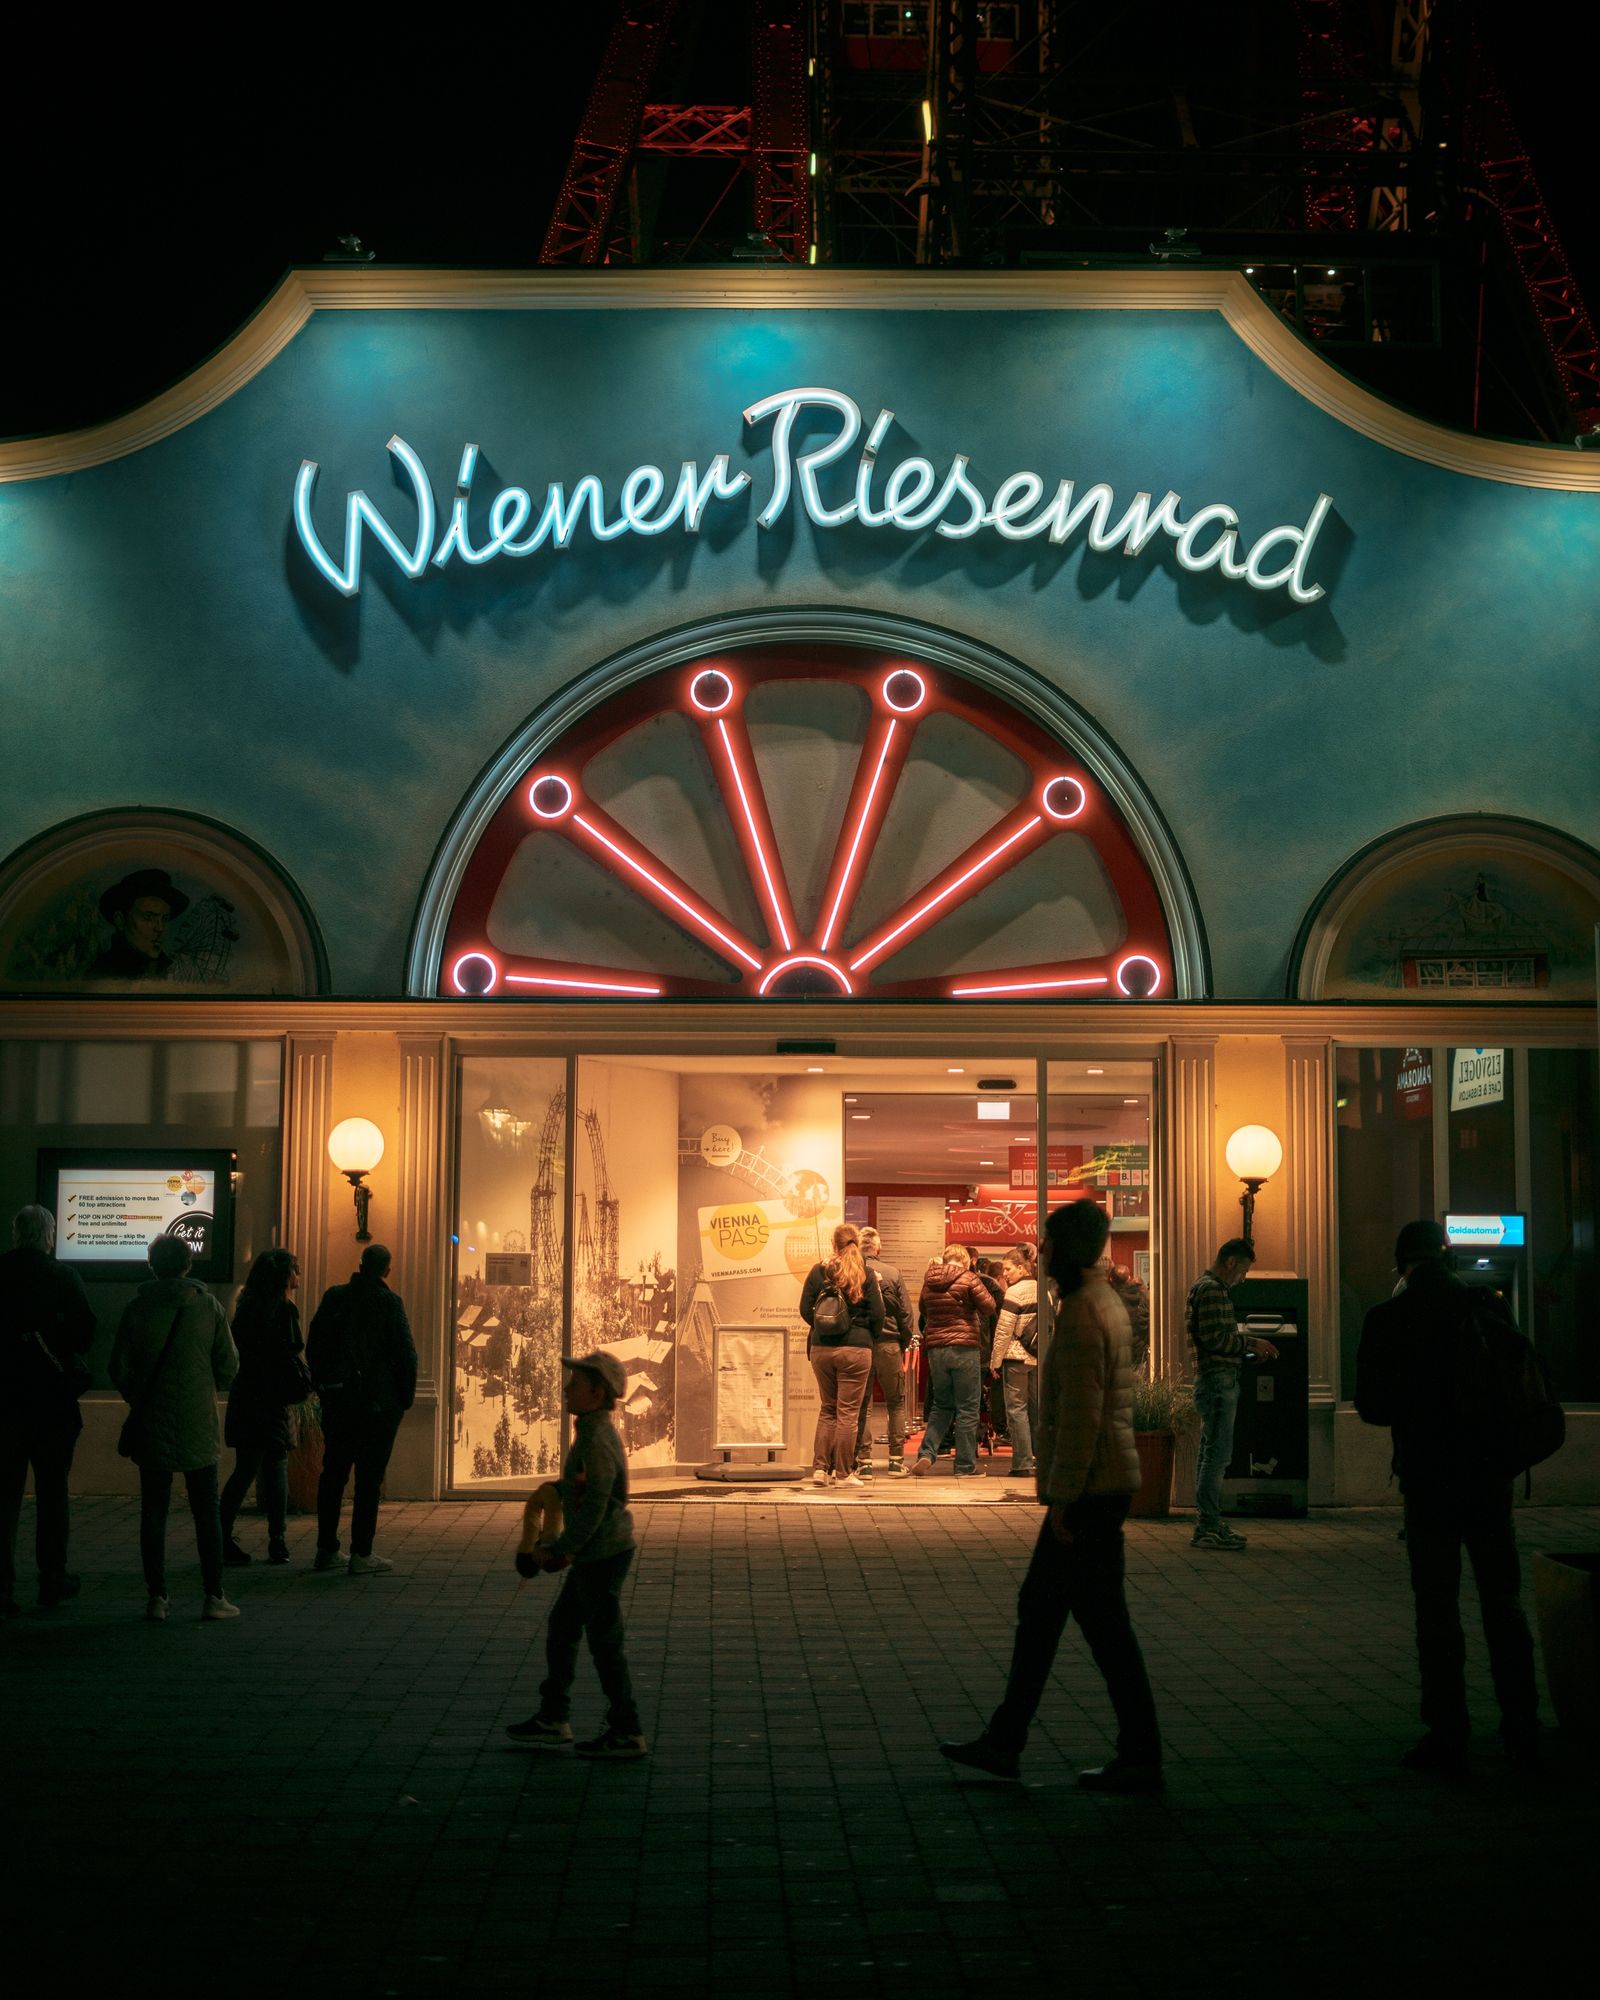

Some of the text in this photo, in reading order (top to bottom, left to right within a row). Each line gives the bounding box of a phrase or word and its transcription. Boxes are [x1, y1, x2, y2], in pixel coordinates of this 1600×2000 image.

[293, 386, 1334, 604] Wiener Riesenrad
[711, 1132, 730, 1146] Buy
[710, 1213, 761, 1230] VIENNA
[194, 1226, 205, 1239] it
[718, 1225, 770, 1249] PASS
[1447, 1226, 1500, 1234] Geldautomat
[711, 1267, 762, 1278] VIENNAPASS.COM
